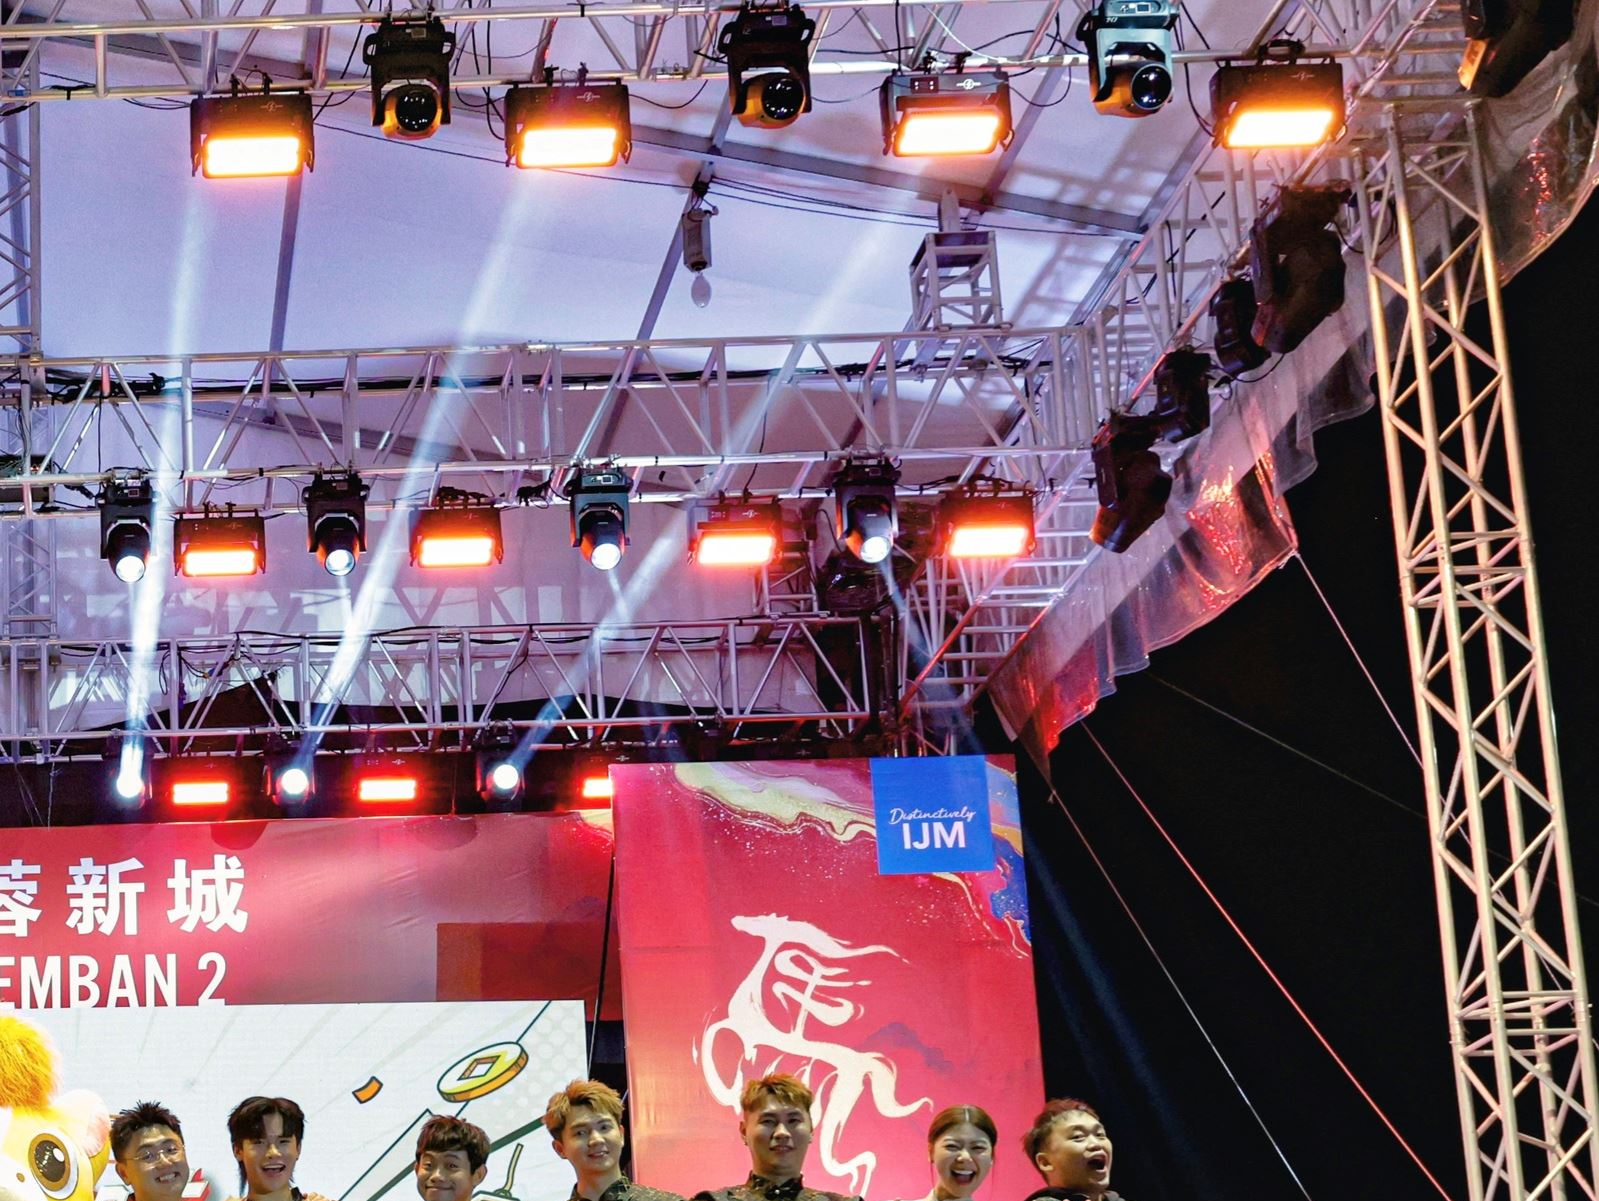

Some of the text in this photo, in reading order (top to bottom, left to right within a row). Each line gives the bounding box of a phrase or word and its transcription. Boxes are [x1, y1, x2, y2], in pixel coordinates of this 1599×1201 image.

[888, 806, 976, 825] Distinctively
[902, 821, 966, 850] IJM
[197, 951, 227, 1007] 2
